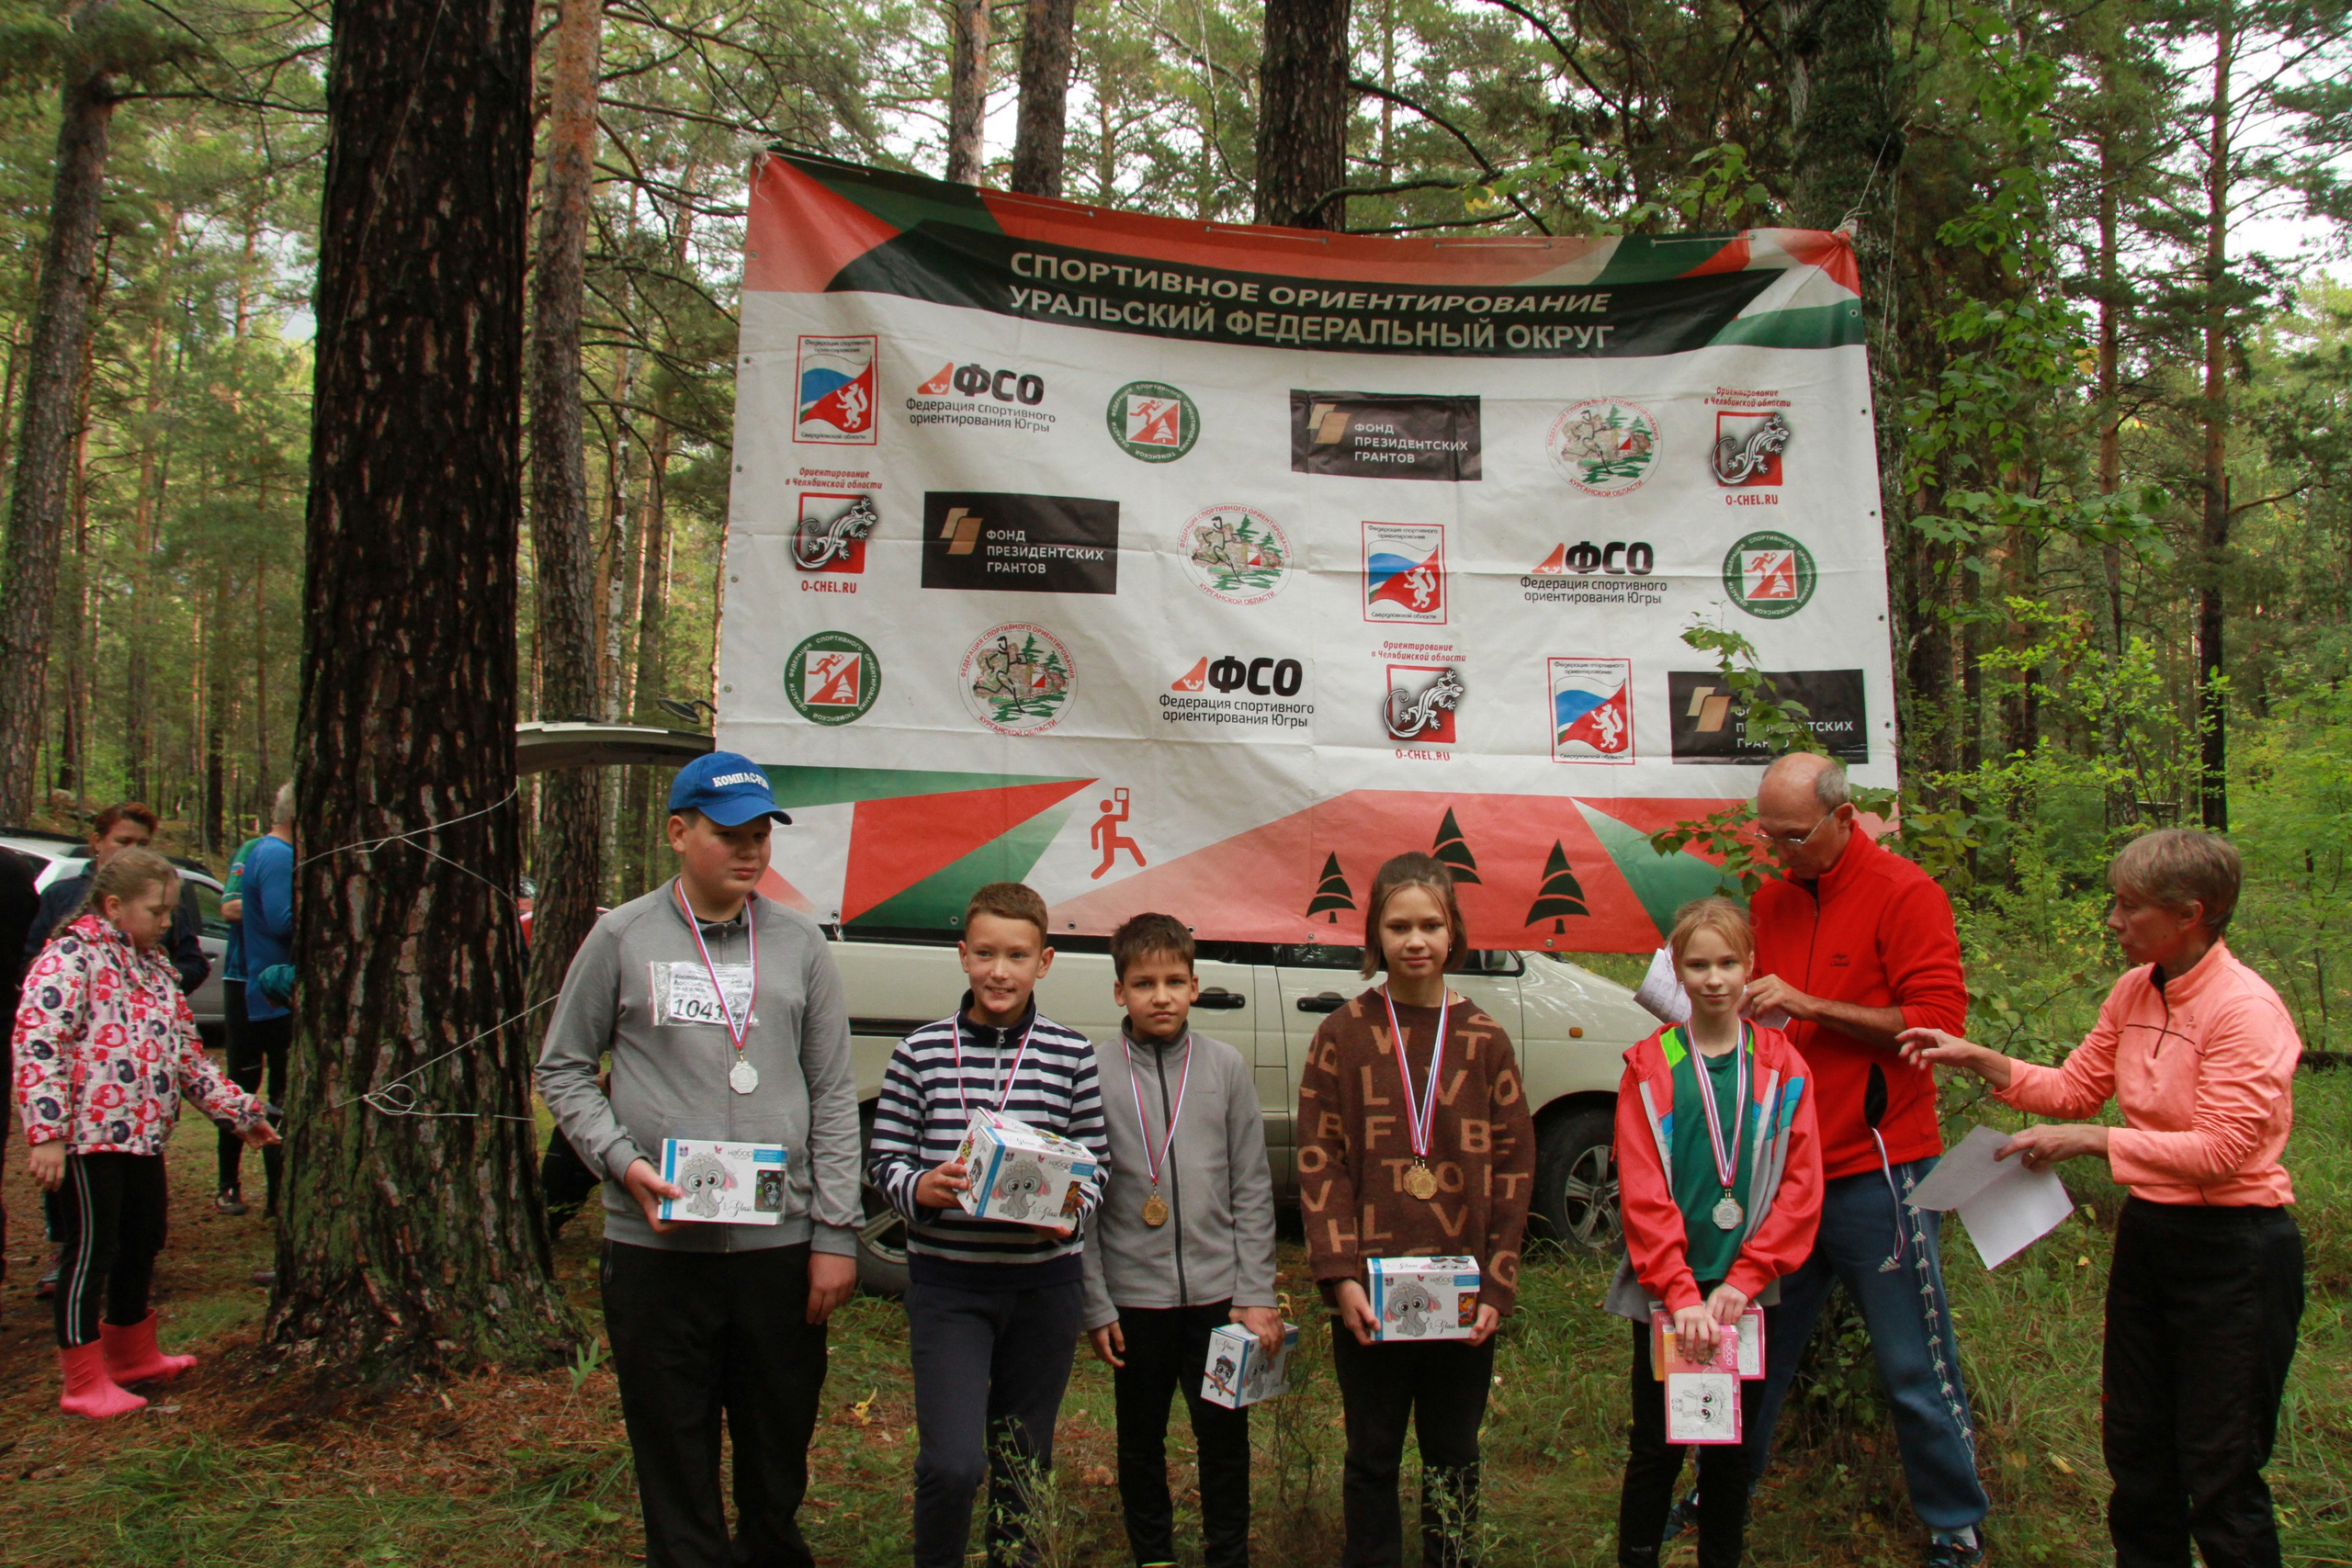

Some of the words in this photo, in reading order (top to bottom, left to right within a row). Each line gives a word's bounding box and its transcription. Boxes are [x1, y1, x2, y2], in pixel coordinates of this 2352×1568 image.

[1011, 252, 1260, 302] СПОРТИВНОЕ
[1269, 286, 1612, 313] ОРИЕНТИРОВАНИЕ
[1009, 285, 1215, 333] УРАЛЬСКИЙ
[1226, 310, 1495, 348] ФЕДЕРАЛЬНЫЙ
[1506, 324, 1614, 349] ОКРУГ
[954, 363, 1044, 405] ФСО
[1716, 387, 1779, 398] Ориентирование
[906, 398, 975, 412] Федерация
[978, 404, 1056, 423] спортивного
[1711, 397, 1755, 407] Челябинской
[1758, 399, 1791, 407] области
[910, 413, 1011, 427] ориентирования
[1014, 418, 1049, 433] Югры
[1354, 423, 1394, 434] ФОНД
[1354, 437, 1468, 451] ПРЕЗИДЕНТСКИХ
[1354, 452, 1415, 463] ГРАНТОВ
[799, 467, 869, 479] Ориентирование
[793, 478, 845, 488] Челябинской
[847, 479, 882, 490] области
[1725, 494, 1778, 505] O-CHEL.RU
[987, 529, 1026, 542] ФОНД
[1180, 516, 1198, 548] ФЕДЕРАЦИЯ
[1198, 505, 1247, 519] СПОРТИВНОГО
[1248, 507, 1290, 558] ОРИЕНТИРОВАНИЯ
[987, 546, 1103, 560] ПРЕЗИДЕНТСКИХ
[1565, 540, 1654, 575] ФСО
[987, 562, 1046, 574] ГРАНТОВ
[801, 580, 856, 593] O-CHEL.RU
[1199, 582, 1243, 604] КУРГАНСКОЙ
[1244, 591, 1275, 605] ОБЛАСТИ
[1521, 576, 1589, 591] Федерация
[1591, 580, 1668, 592] спортивного
[1524, 591, 1623, 604] ориентирования
[1627, 592, 1661, 606] Югры
[816, 635, 863, 651] СПОРТИВНОГО
[960, 638, 984, 678] ФЕДЕРАЦИЯ
[983, 624, 1032, 640] СПОРТИВНОГО
[1032, 626, 1075, 679] ОРИЕНТИРОВАНИЯ
[1384, 640, 1453, 651] Ориентирование
[1378, 650, 1429, 660] Челябинской
[1430, 652, 1466, 661] области
[1208, 655, 1303, 696] ФСО
[1159, 694, 1231, 710] Федерация
[1234, 702, 1315, 715] спортивного
[978, 716, 1022, 736] КУРГАНСКОЙ
[1023, 718, 1057, 736] ОБЛАСТИ
[1162, 710, 1268, 725] ориентирования
[1272, 714, 1307, 729] Югры
[1736, 738, 1790, 749] ГРАН
[1395, 749, 1451, 761] O-CHEL.RU
[1455, 1031, 1492, 1060] T
[1361, 1065, 1389, 1106] L
[1317, 1111, 1342, 1139] B
[1365, 1115, 1396, 1150] F
[1461, 1118, 1492, 1153] B
[728, 1148, 753, 1157] набор
[1297, 1145, 1328, 1173] O
[1048, 1160, 1071, 1169] набор
[1497, 1173, 1529, 1199] T
[1301, 1180, 1332, 1213] V
[1363, 1204, 1392, 1239] L
[1430, 1202, 1468, 1237] V
[1430, 1276, 1453, 1285] набор
[1725, 1337, 1736, 1366] набор
